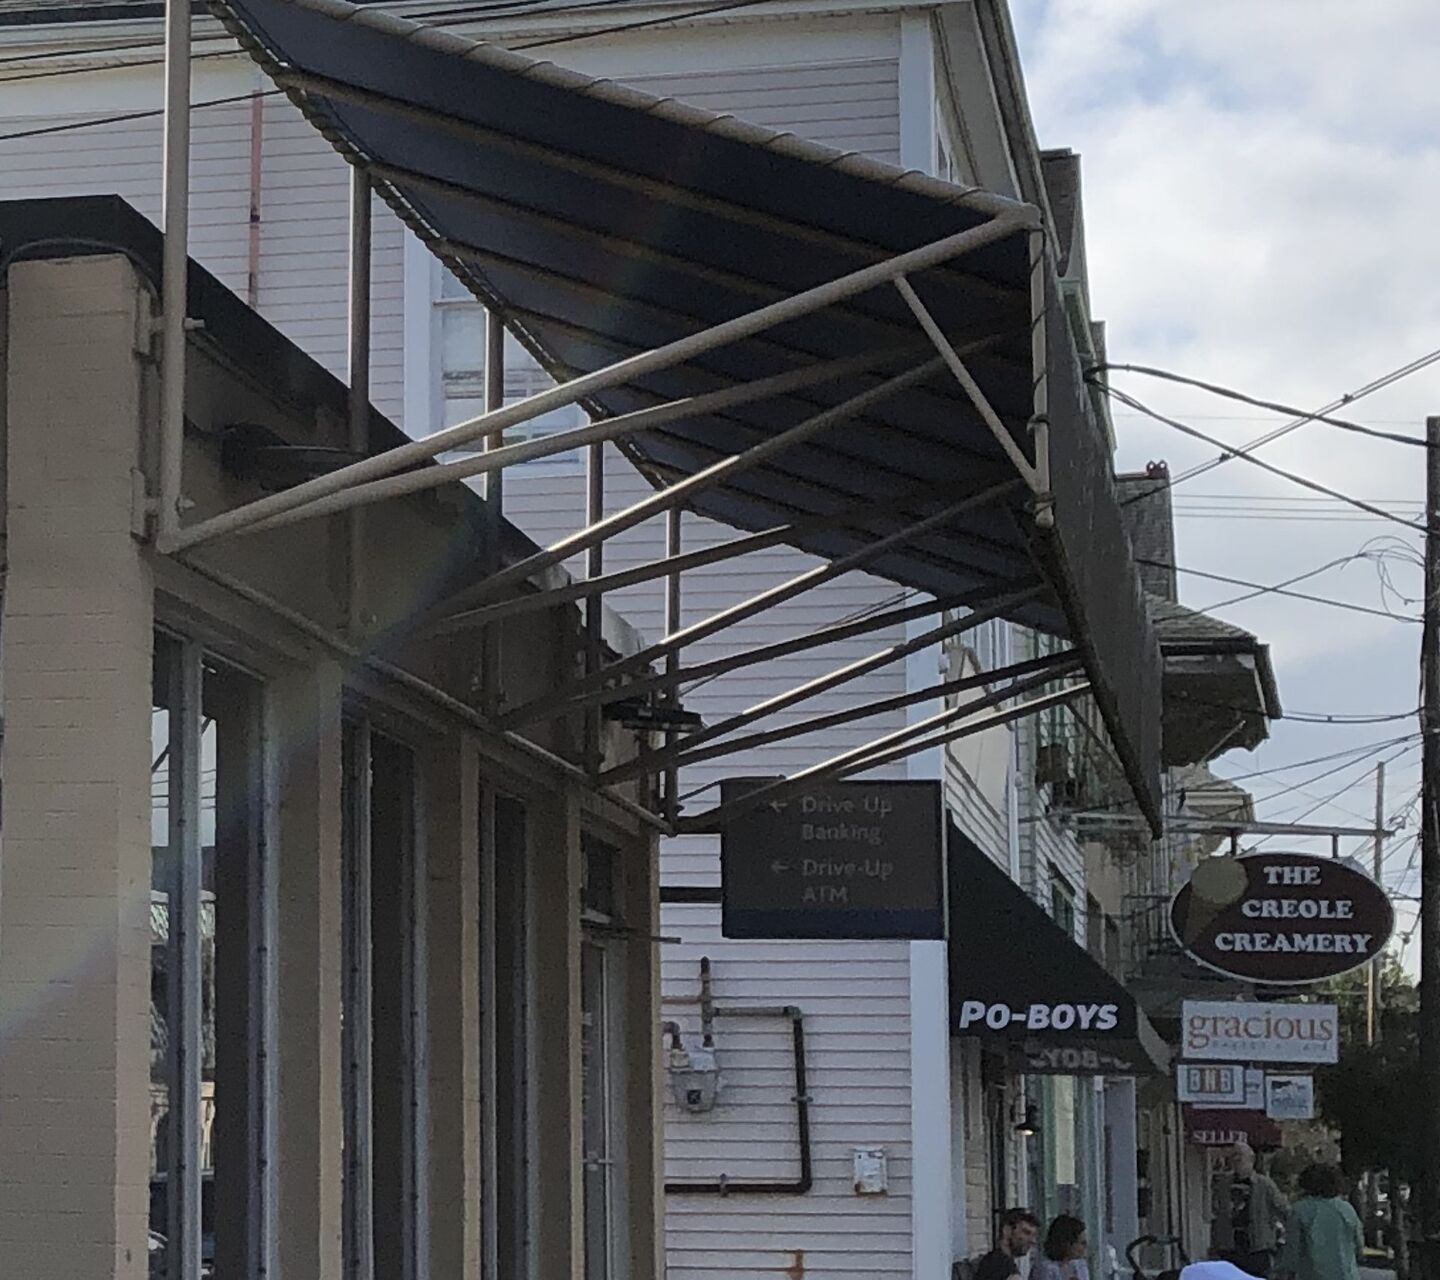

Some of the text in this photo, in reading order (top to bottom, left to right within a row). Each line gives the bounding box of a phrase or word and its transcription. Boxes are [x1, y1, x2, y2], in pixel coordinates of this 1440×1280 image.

[801, 796, 893, 818] Drive Up
[801, 822, 882, 846] Banking
[801, 858, 893, 881] Drive-Up
[1263, 865, 1322, 885] THE
[802, 886, 848, 903] ATM
[1241, 899, 1354, 919] CREOLE
[1214, 932, 1373, 953] CREAMERY
[959, 1000, 1119, 1030] PO-BOYS
[1188, 1011, 1333, 1050] gracious
